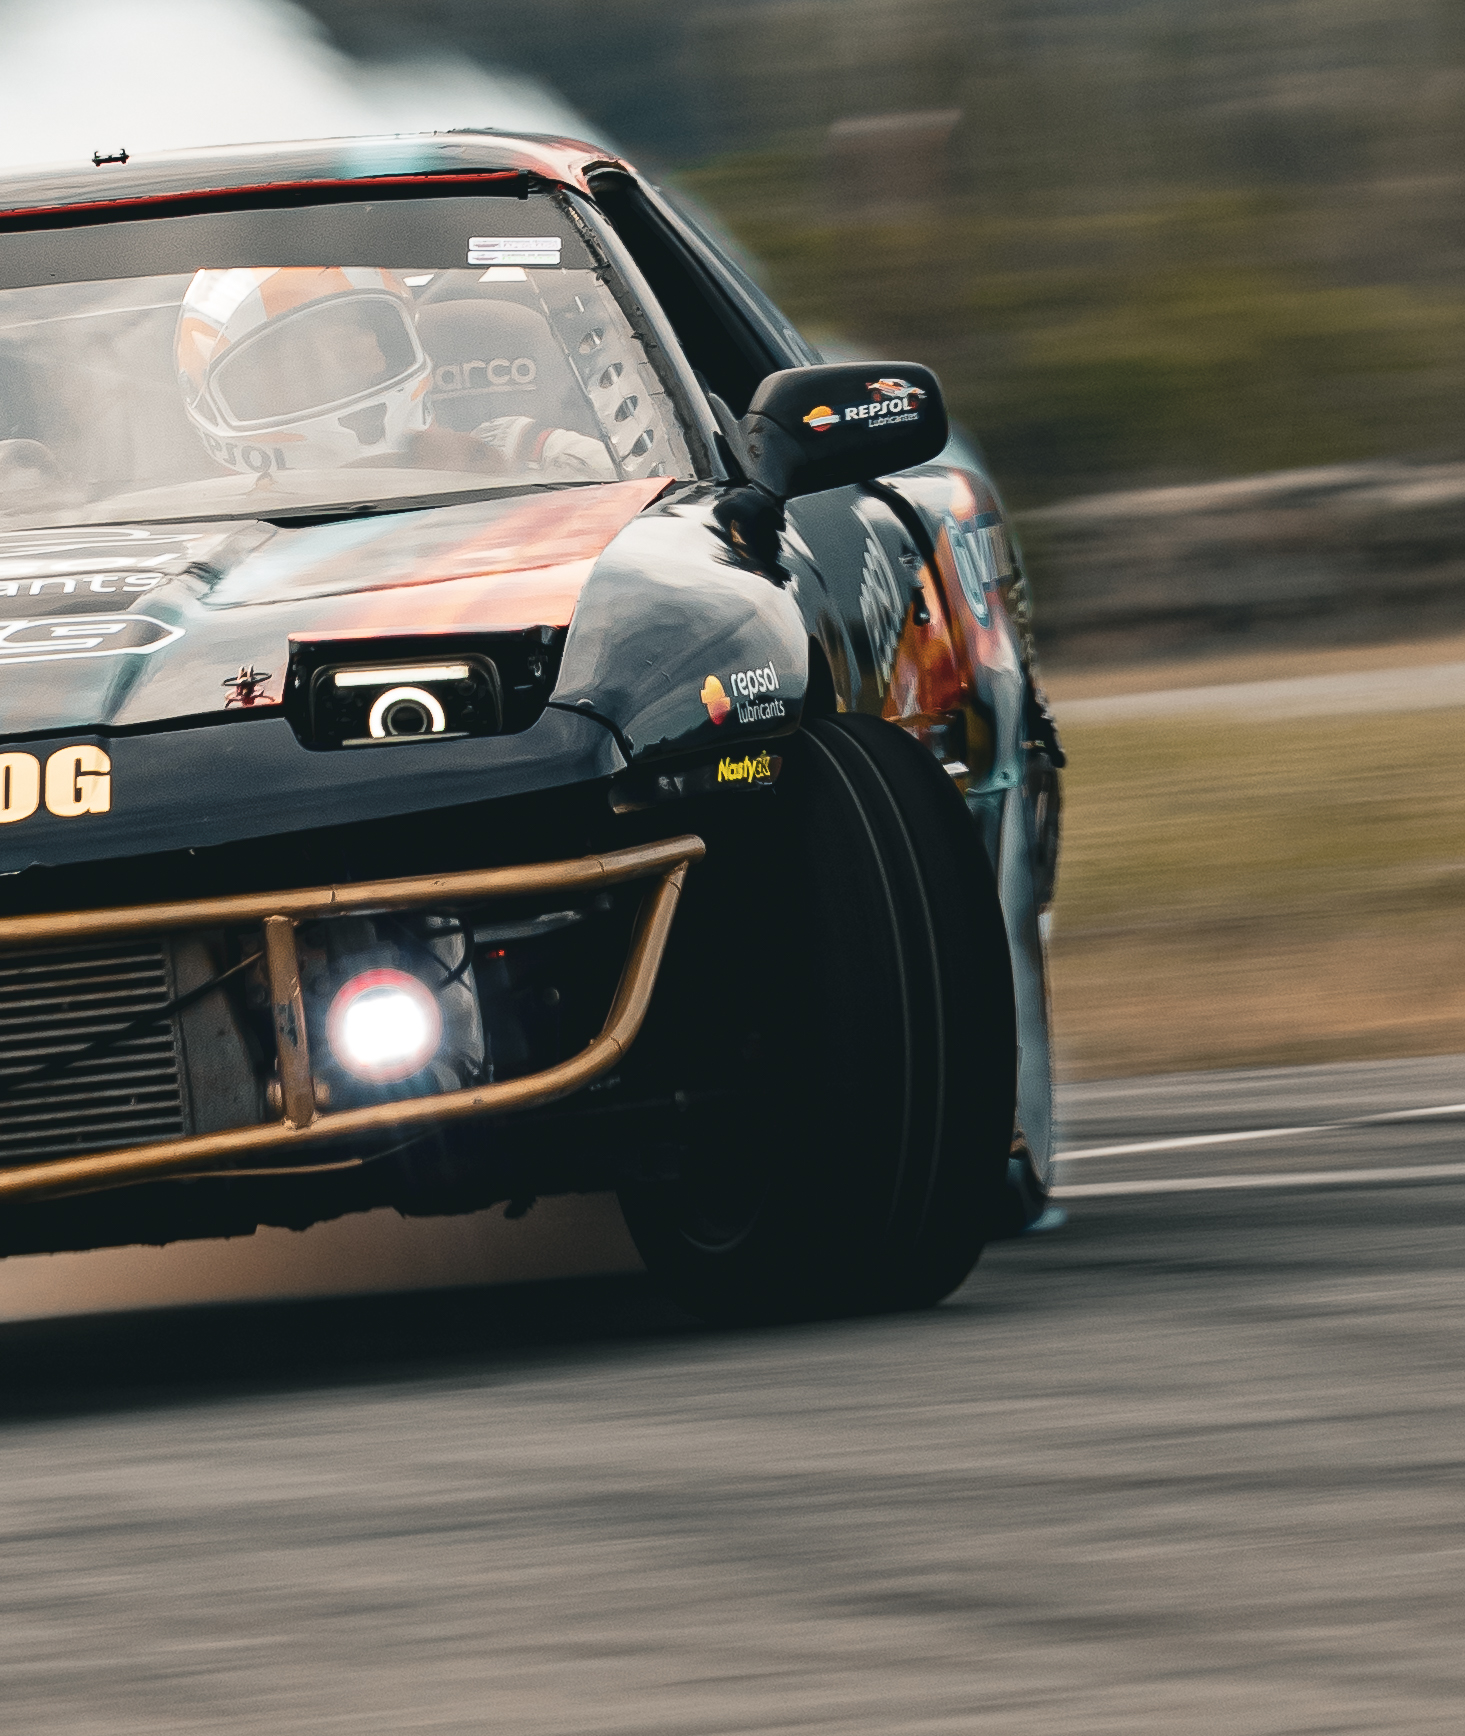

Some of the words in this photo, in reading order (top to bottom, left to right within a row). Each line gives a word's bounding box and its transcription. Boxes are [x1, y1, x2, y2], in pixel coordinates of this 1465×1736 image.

[434, 357, 537, 389] arco
[844, 397, 914, 421] REPSOL
[730, 660, 779, 700] repsol
[736, 698, 785, 724] lubricants
